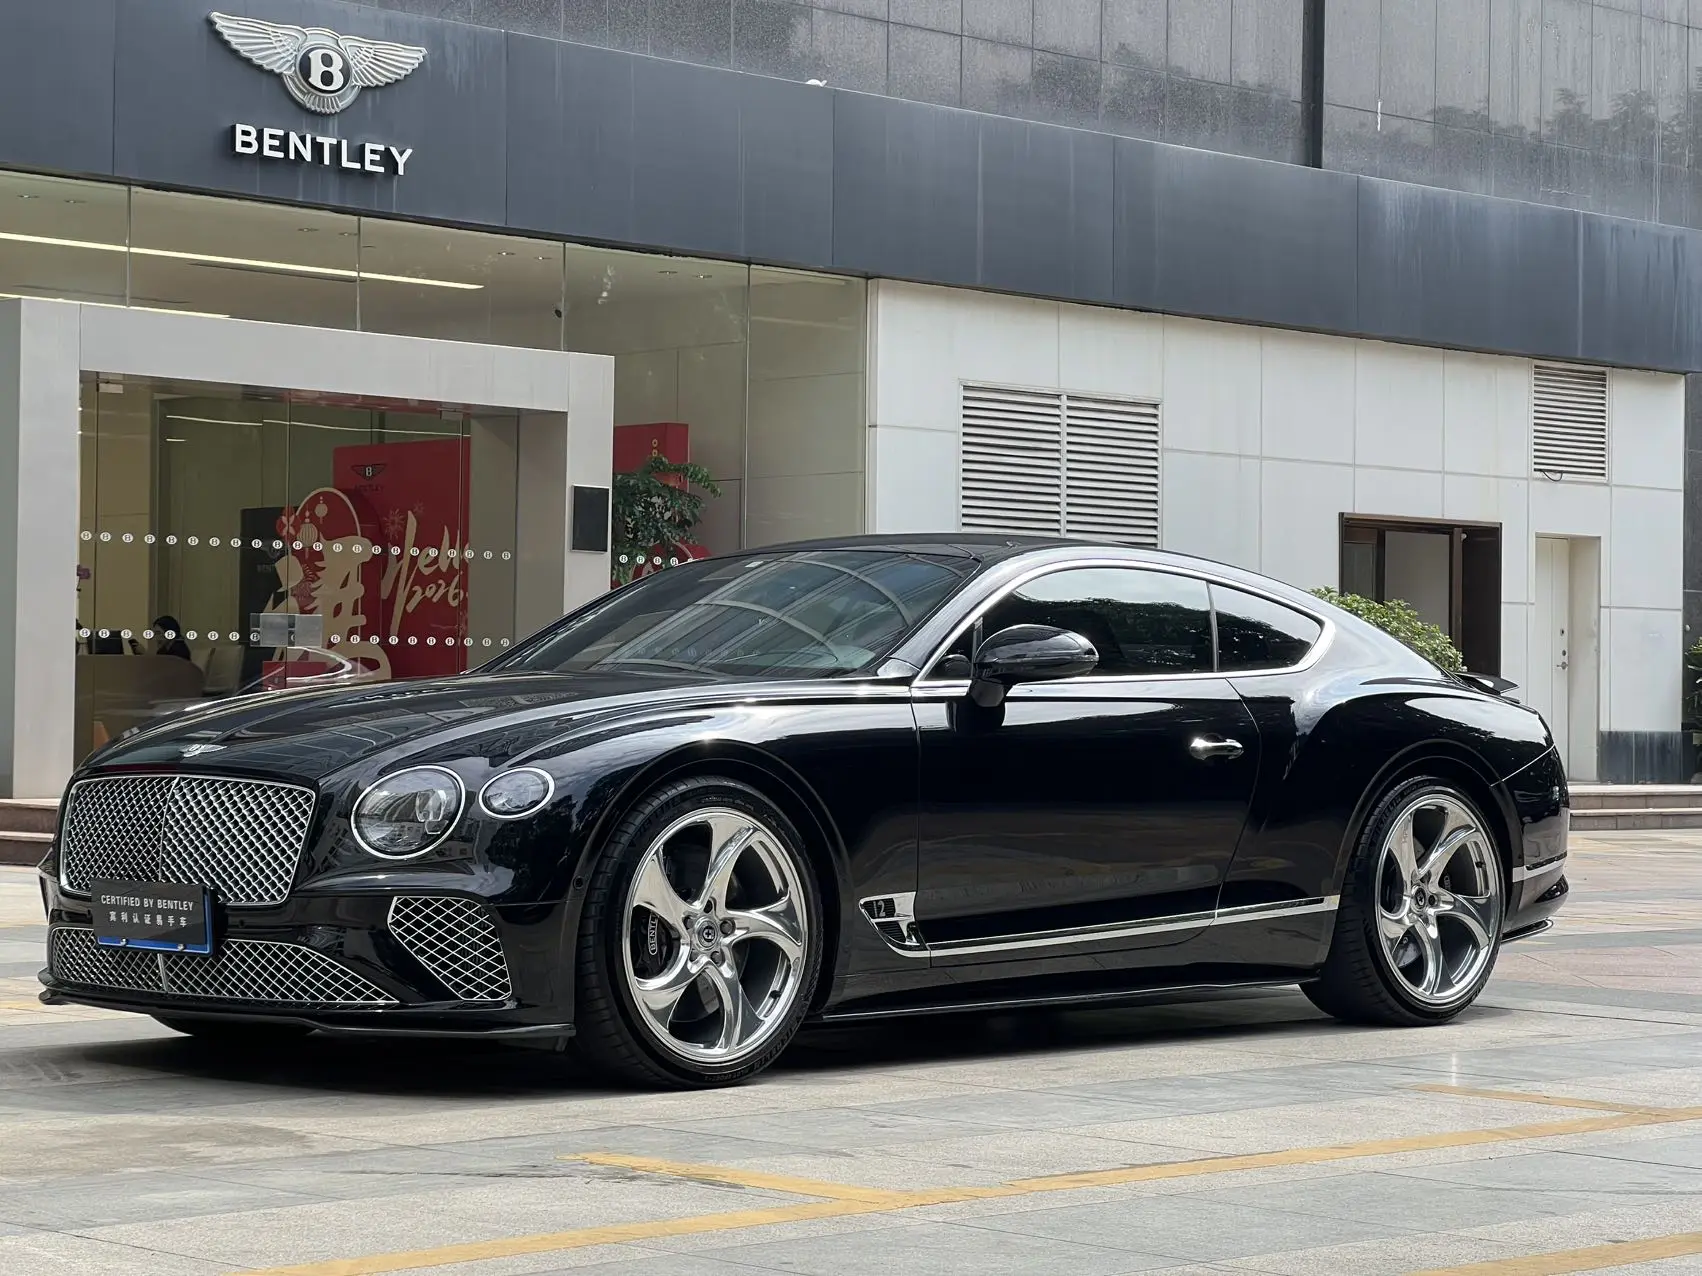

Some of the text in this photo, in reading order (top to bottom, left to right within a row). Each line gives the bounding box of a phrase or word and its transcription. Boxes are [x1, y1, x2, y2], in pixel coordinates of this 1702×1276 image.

[308, 49, 344, 91] B
[235, 123, 413, 176] BENTLEY
[406, 579, 464, 613] 2026
[101, 895, 194, 911] CERTIFIED BY BENTLEY
[873, 900, 886, 918] 12
